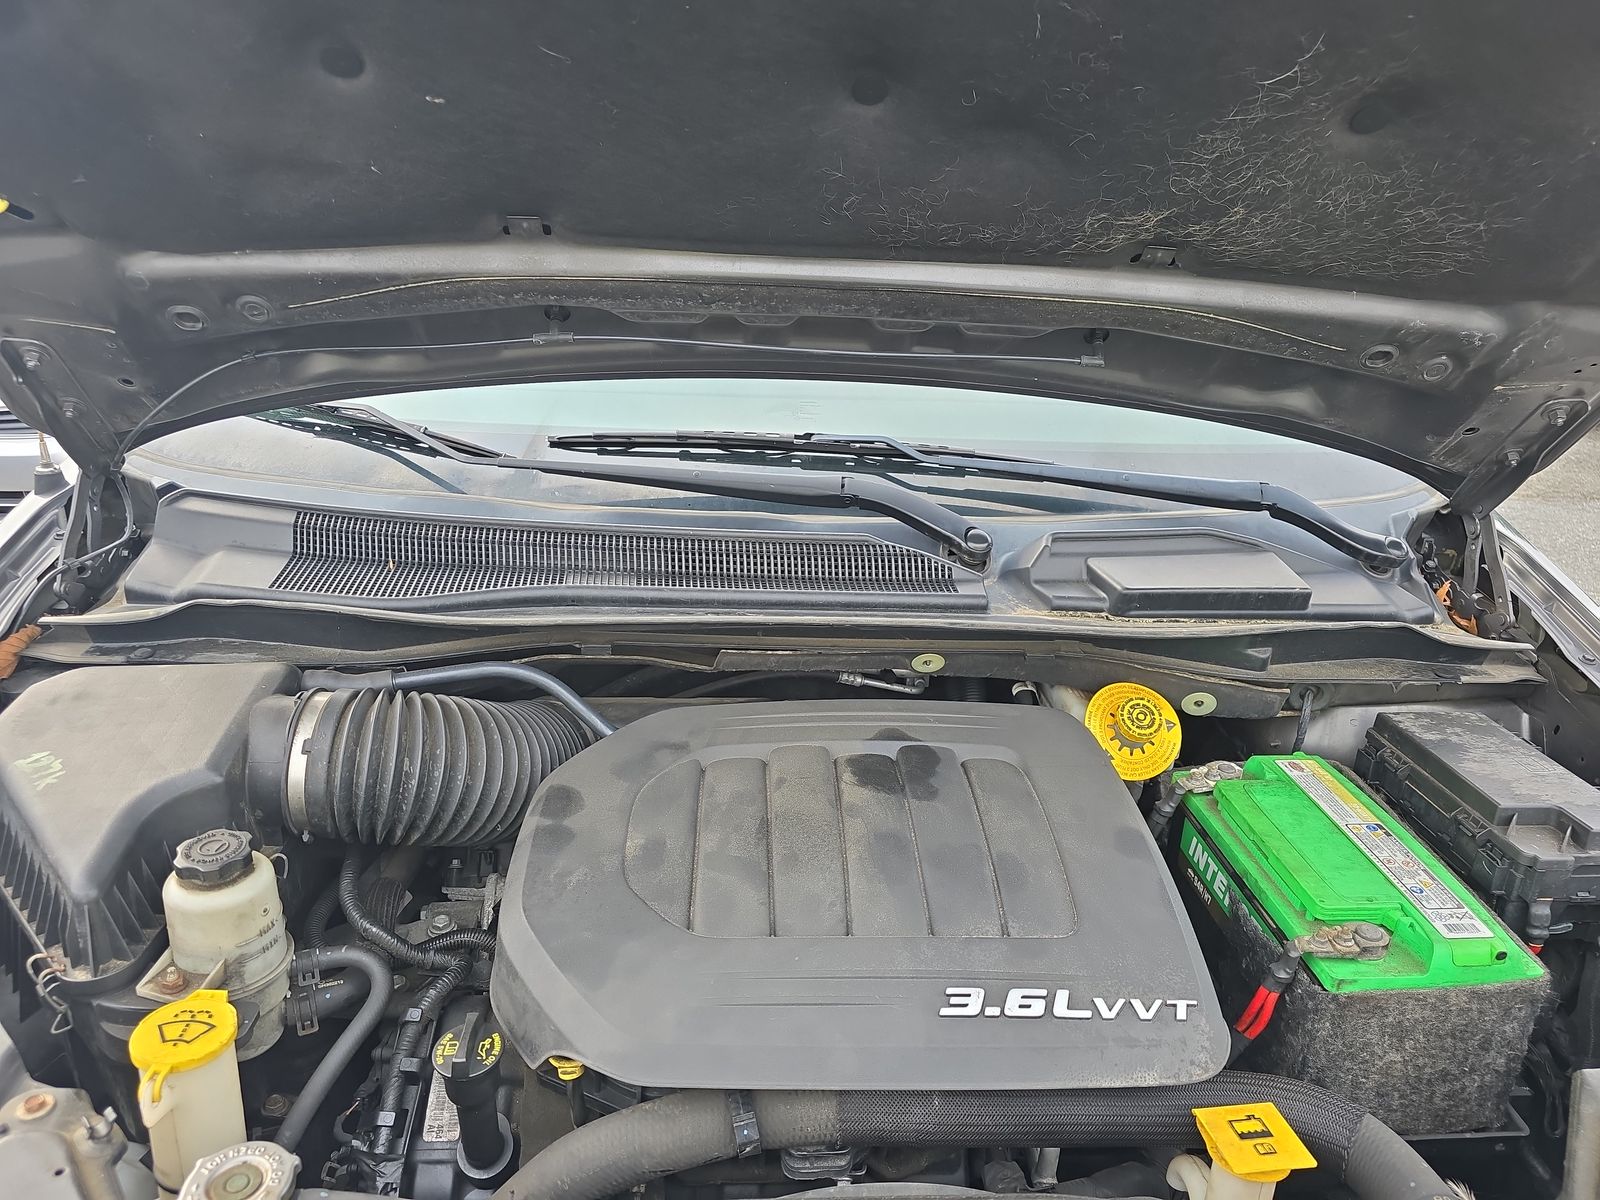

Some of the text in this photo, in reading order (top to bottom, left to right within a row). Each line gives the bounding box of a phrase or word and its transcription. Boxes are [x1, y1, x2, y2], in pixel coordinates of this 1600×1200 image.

[939, 987, 1199, 1021] 3.6L VVT
[482, 1032, 503, 1067] ENGINE OIL
